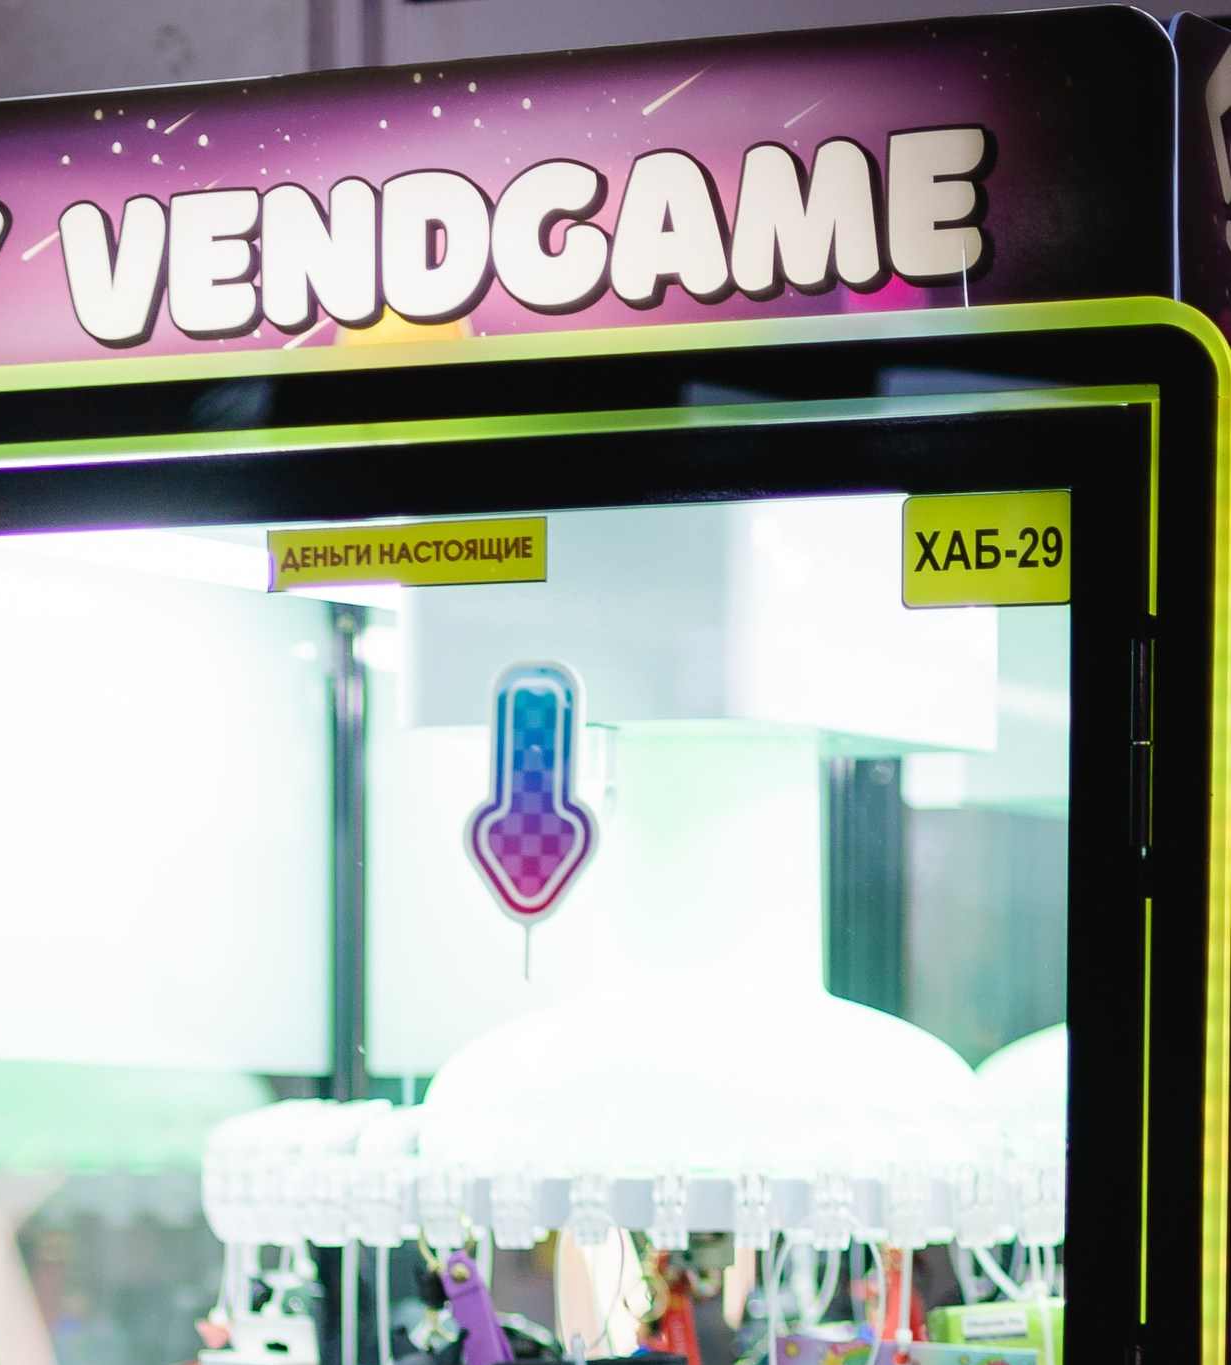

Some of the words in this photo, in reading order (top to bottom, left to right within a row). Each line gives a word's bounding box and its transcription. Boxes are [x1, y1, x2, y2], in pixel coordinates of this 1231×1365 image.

[58, 122, 998, 350] VENDGAME
[280, 543, 371, 572] ДЕНЬГИ
[379, 536, 533, 564] НАСТОЯЩИЕ
[914, 526, 1063, 572] ХАБ-29
